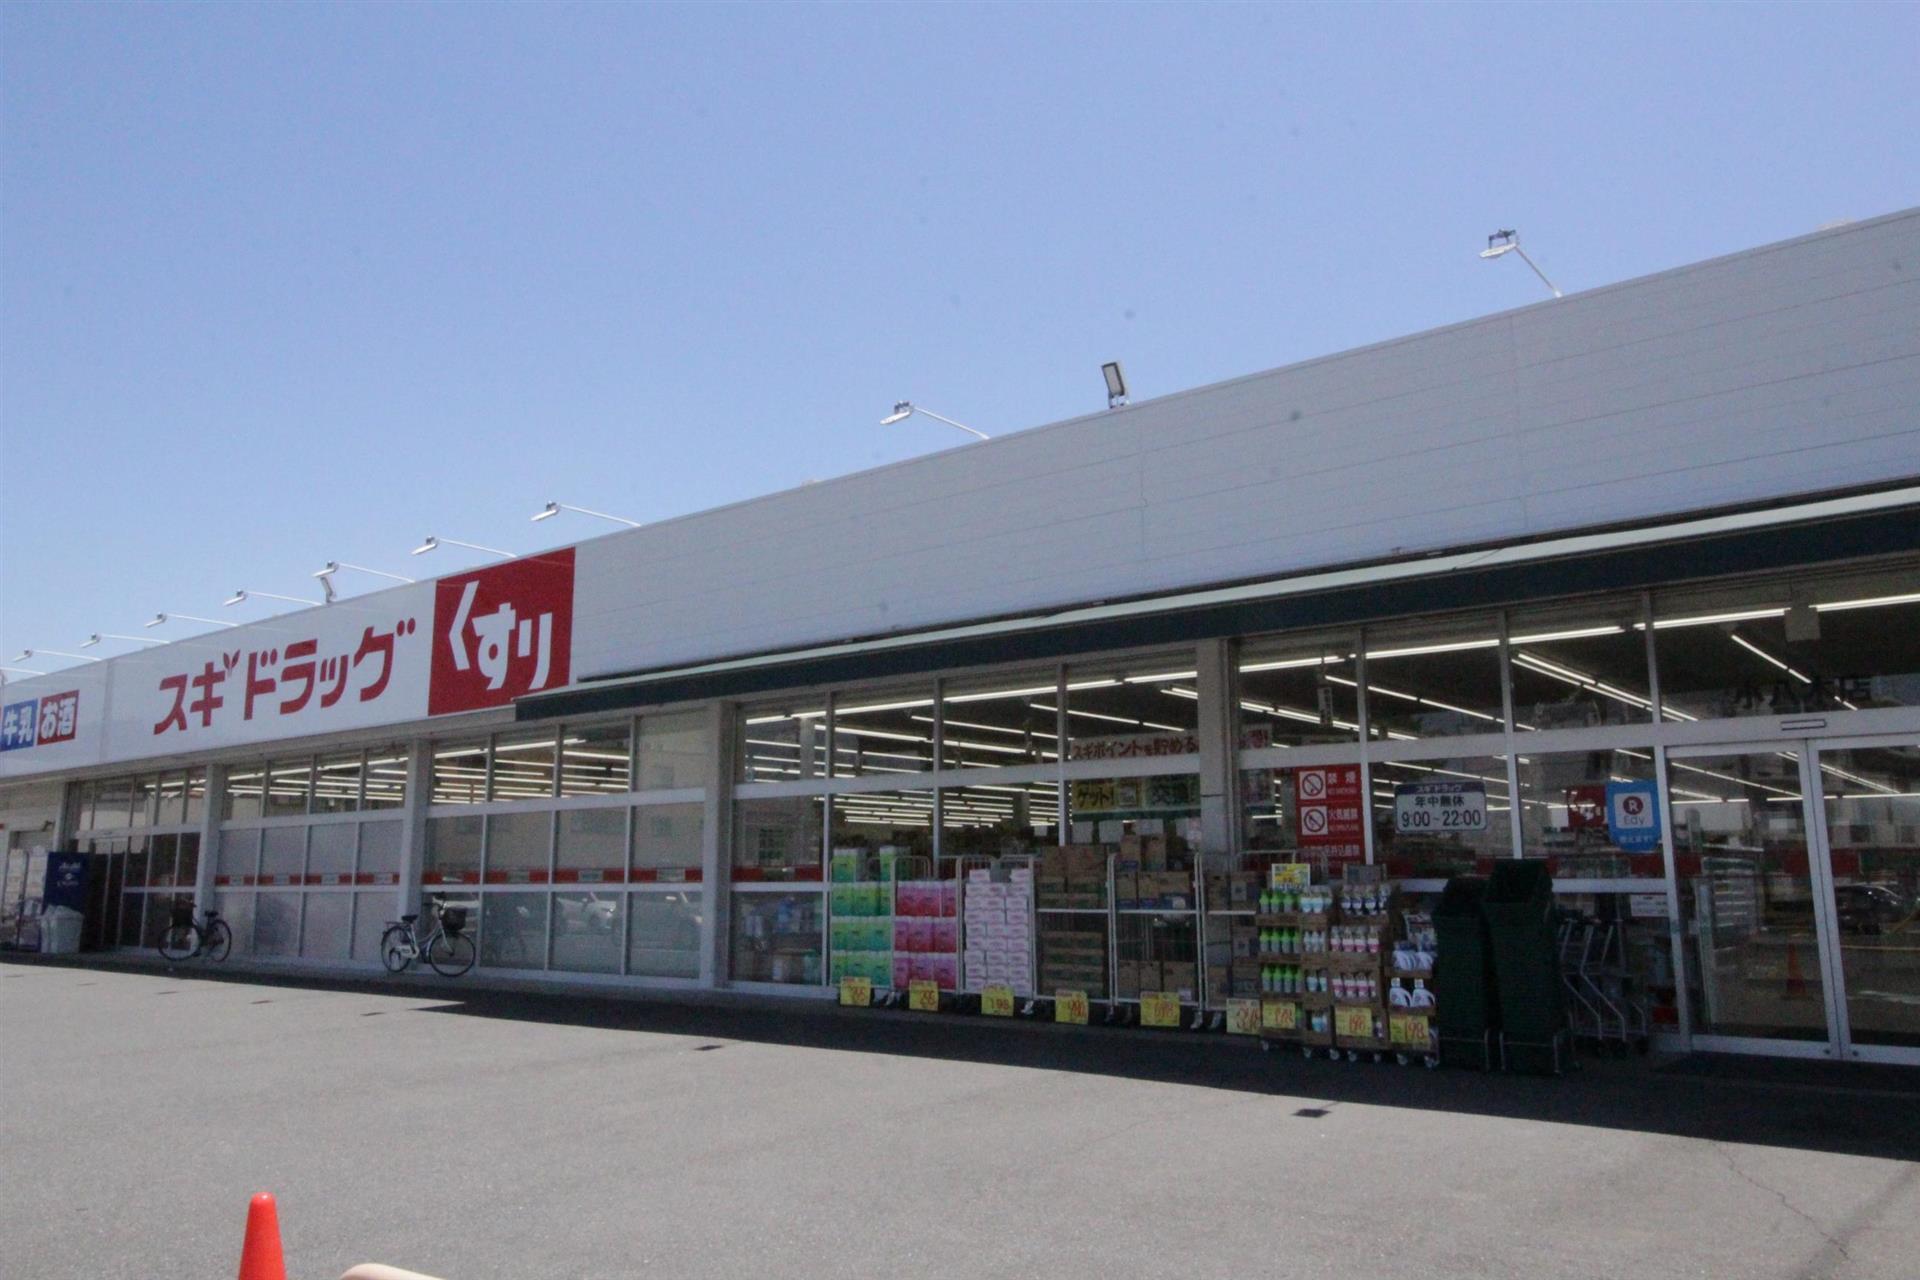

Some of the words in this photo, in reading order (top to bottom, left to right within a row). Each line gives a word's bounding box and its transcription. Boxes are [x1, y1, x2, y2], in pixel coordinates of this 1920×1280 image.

[448, 580, 552, 691] くすり
[153, 617, 417, 735] スギドラッグ
[3, 705, 33, 746] 牛乳
[40, 696, 77, 739] お酒
[1415, 795, 1465, 808] 年中無休
